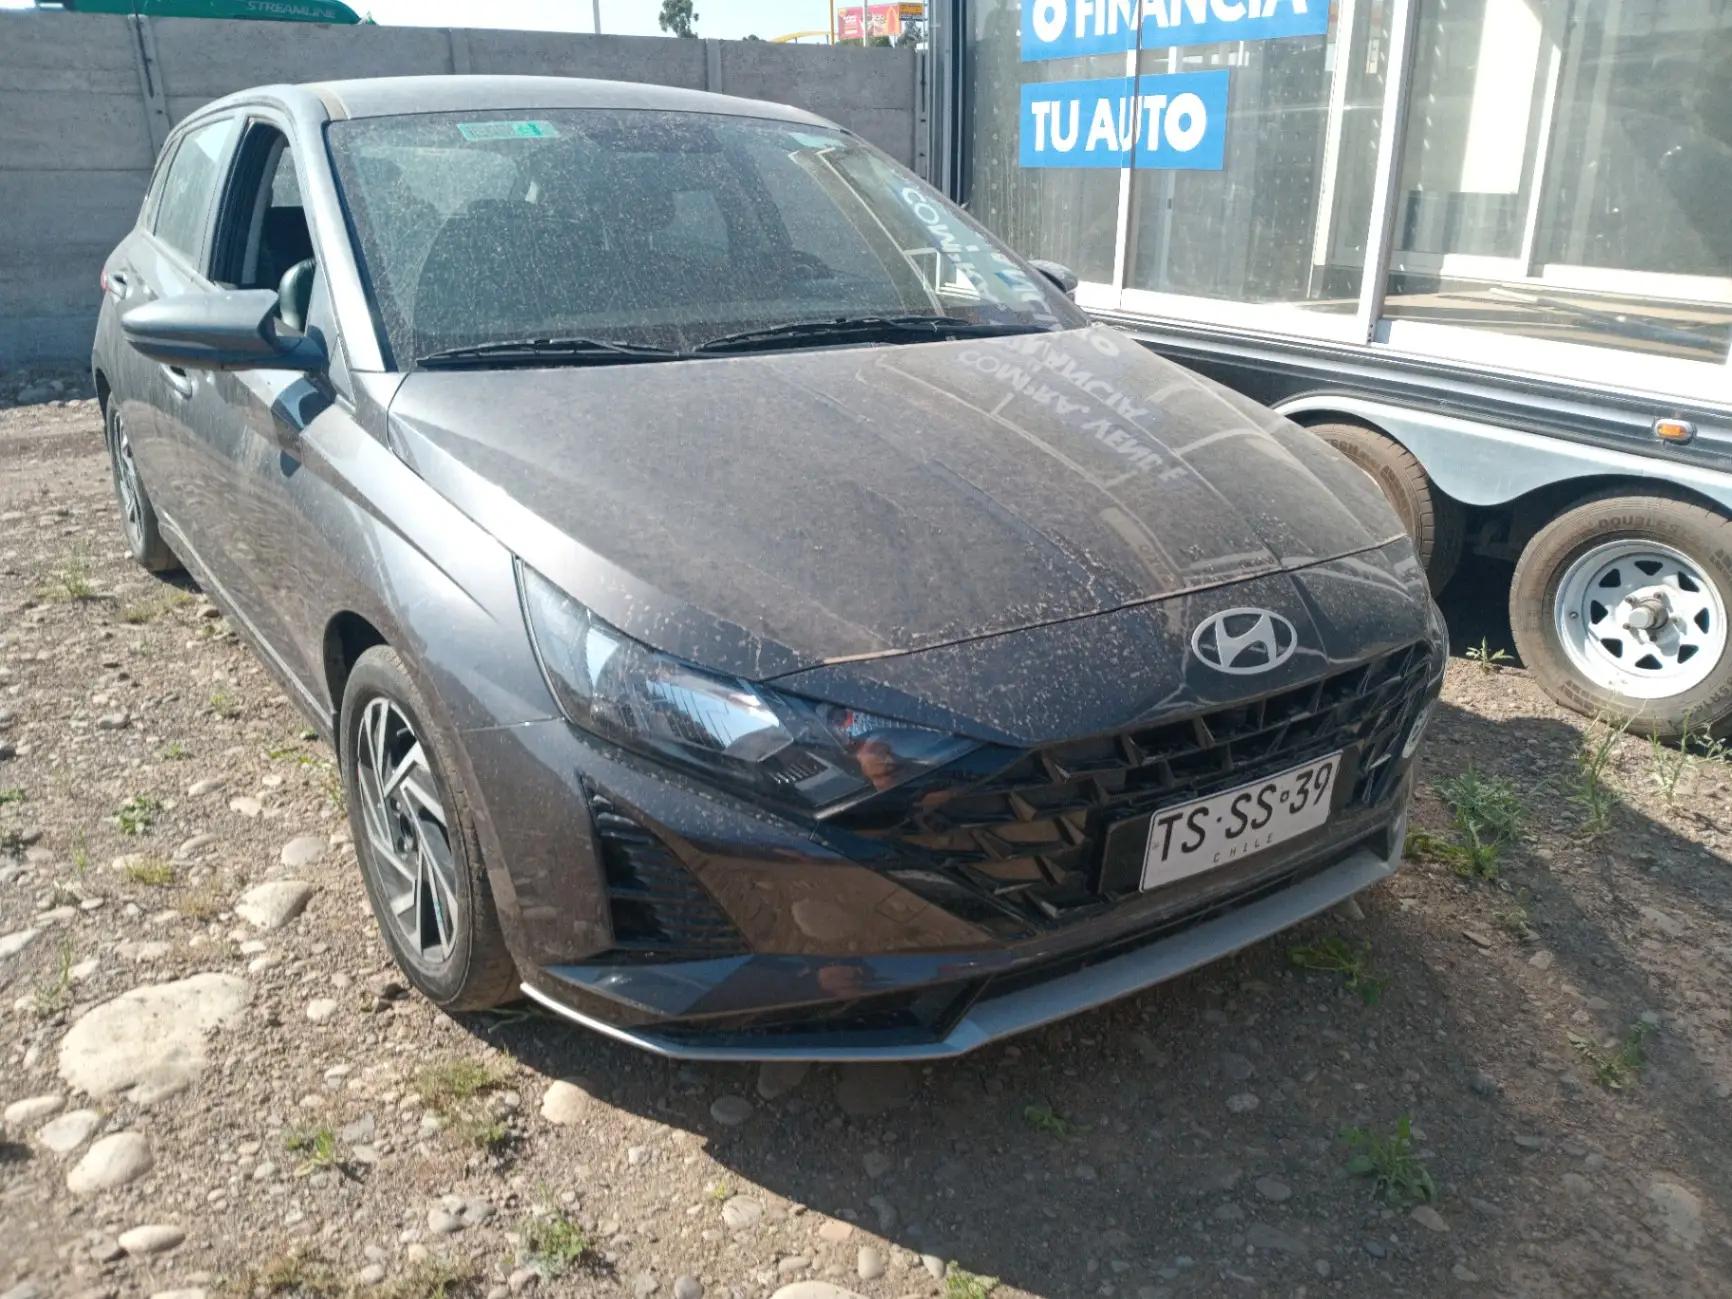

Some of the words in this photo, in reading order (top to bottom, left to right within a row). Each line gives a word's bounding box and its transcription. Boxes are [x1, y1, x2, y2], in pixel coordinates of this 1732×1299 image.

[248, 1, 336, 18] STREAMLINE
[1031, 0, 1068, 43] O
[1074, 0, 1309, 39] FINAN
[1031, 99, 1081, 152] TU
[1085, 92, 1207, 152] AUTO
[1213, 832, 1274, 863] CHILE
